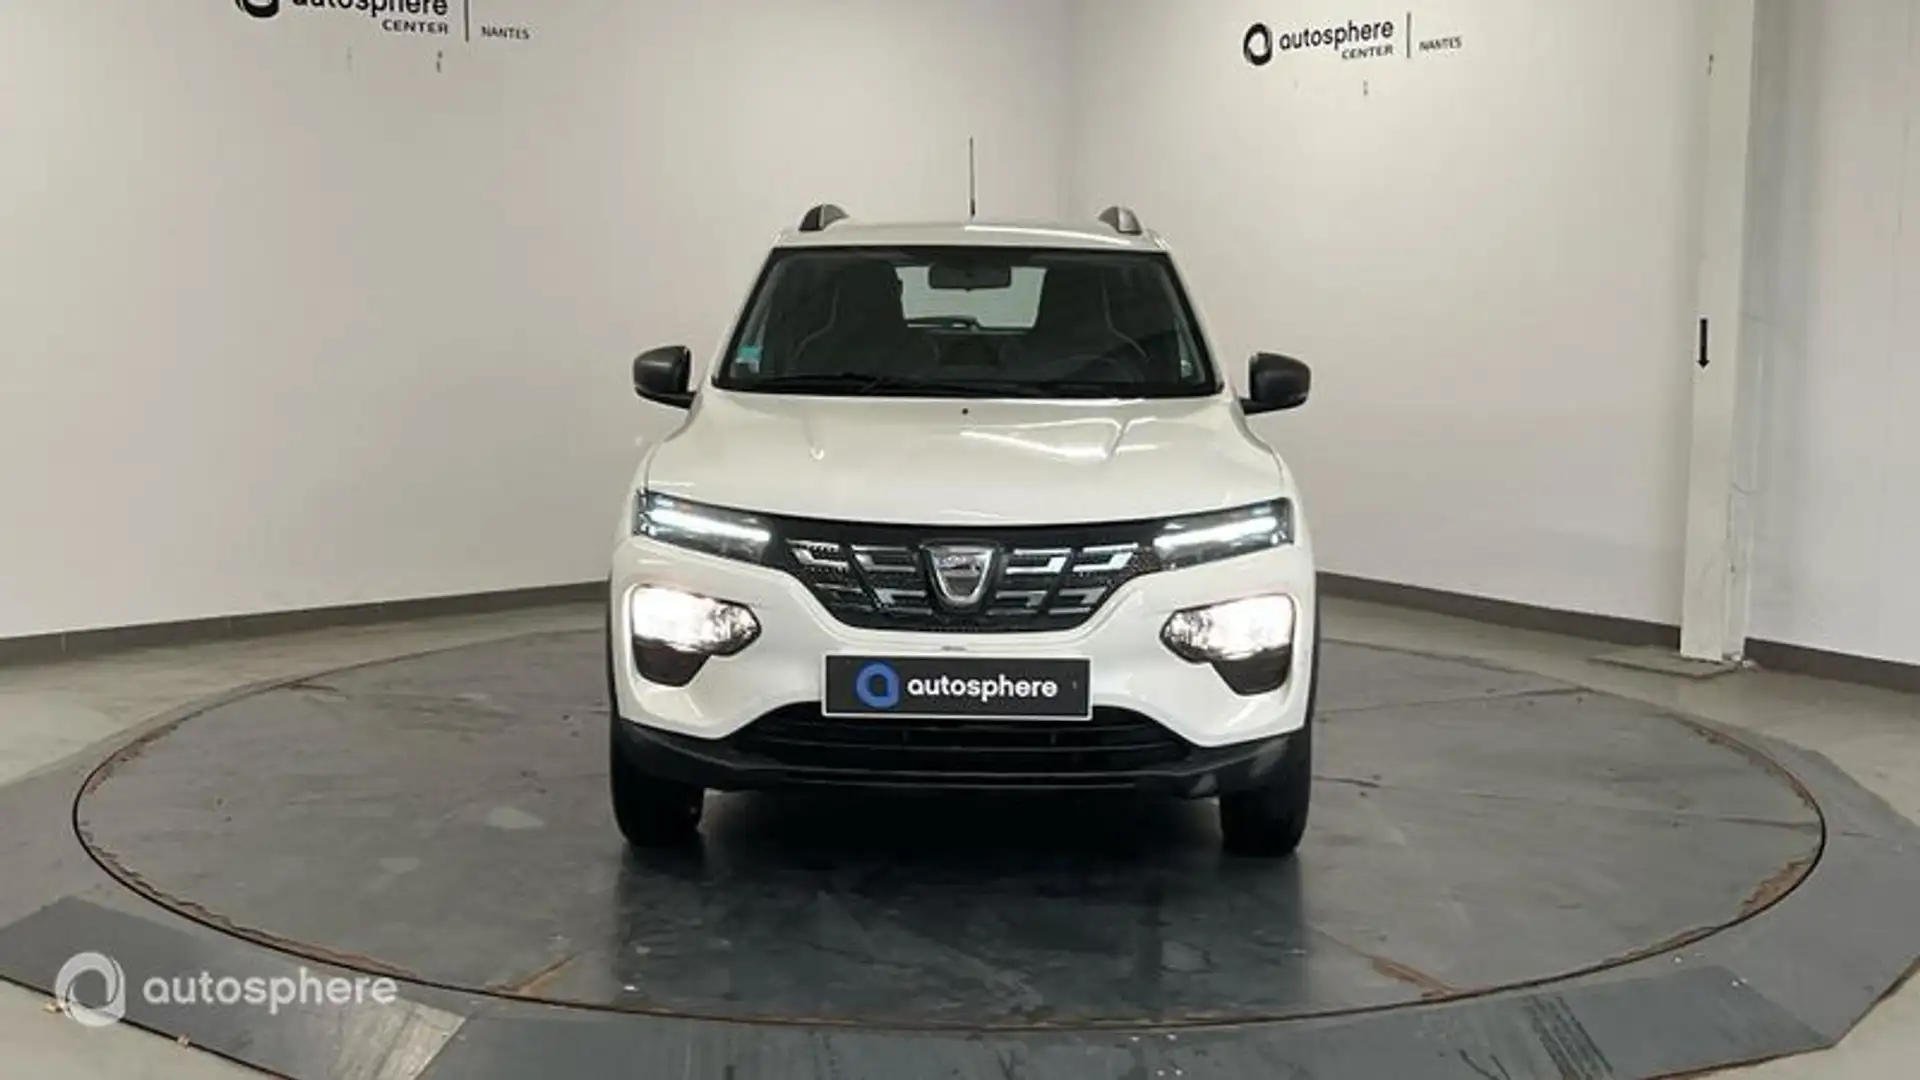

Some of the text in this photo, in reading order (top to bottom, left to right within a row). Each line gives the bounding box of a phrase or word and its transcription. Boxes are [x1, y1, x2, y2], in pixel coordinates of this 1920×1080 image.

[381, 18, 449, 35] CENTER
[480, 25, 530, 40] NANTES
[1279, 19, 1394, 50] autosphere
[1341, 45, 1393, 60] CENTER
[907, 674, 1058, 702] autosphere
